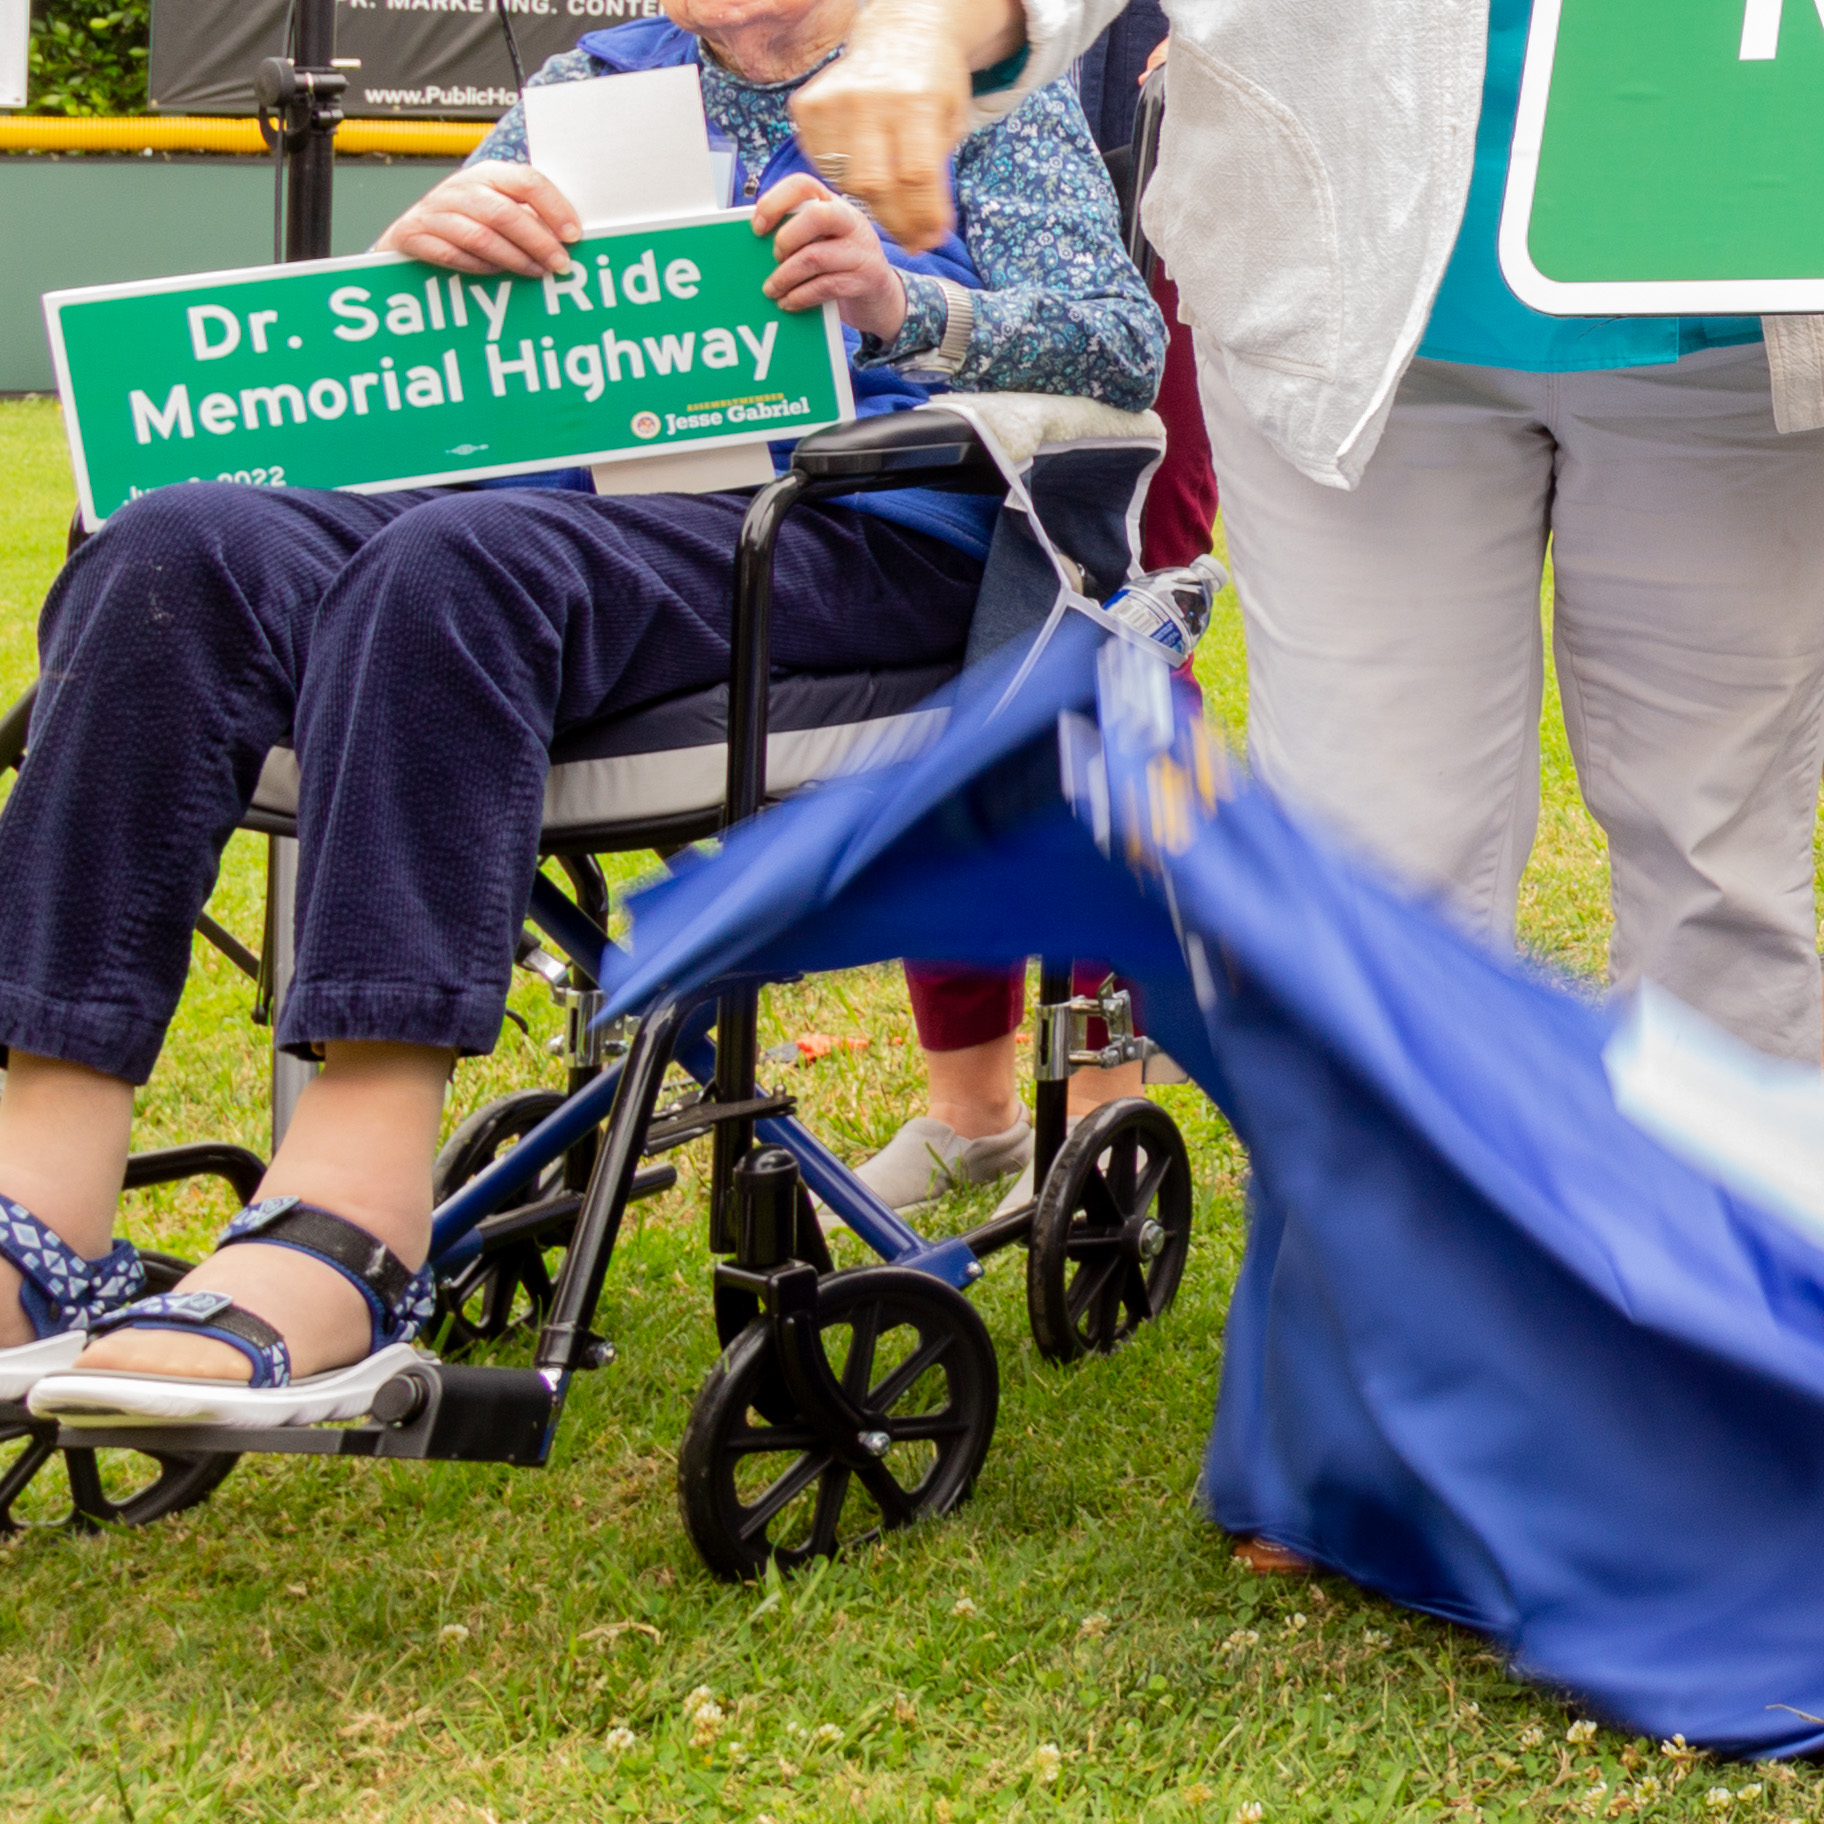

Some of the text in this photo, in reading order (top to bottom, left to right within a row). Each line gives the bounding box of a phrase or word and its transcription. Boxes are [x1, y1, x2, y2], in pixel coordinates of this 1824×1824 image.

[365, 85, 519, 106] www.PublicHa
[187, 249, 703, 360] Dr. Sally Ride
[128, 320, 779, 445] Memorial Highway
[664, 396, 811, 435] Jesse Gabriel
